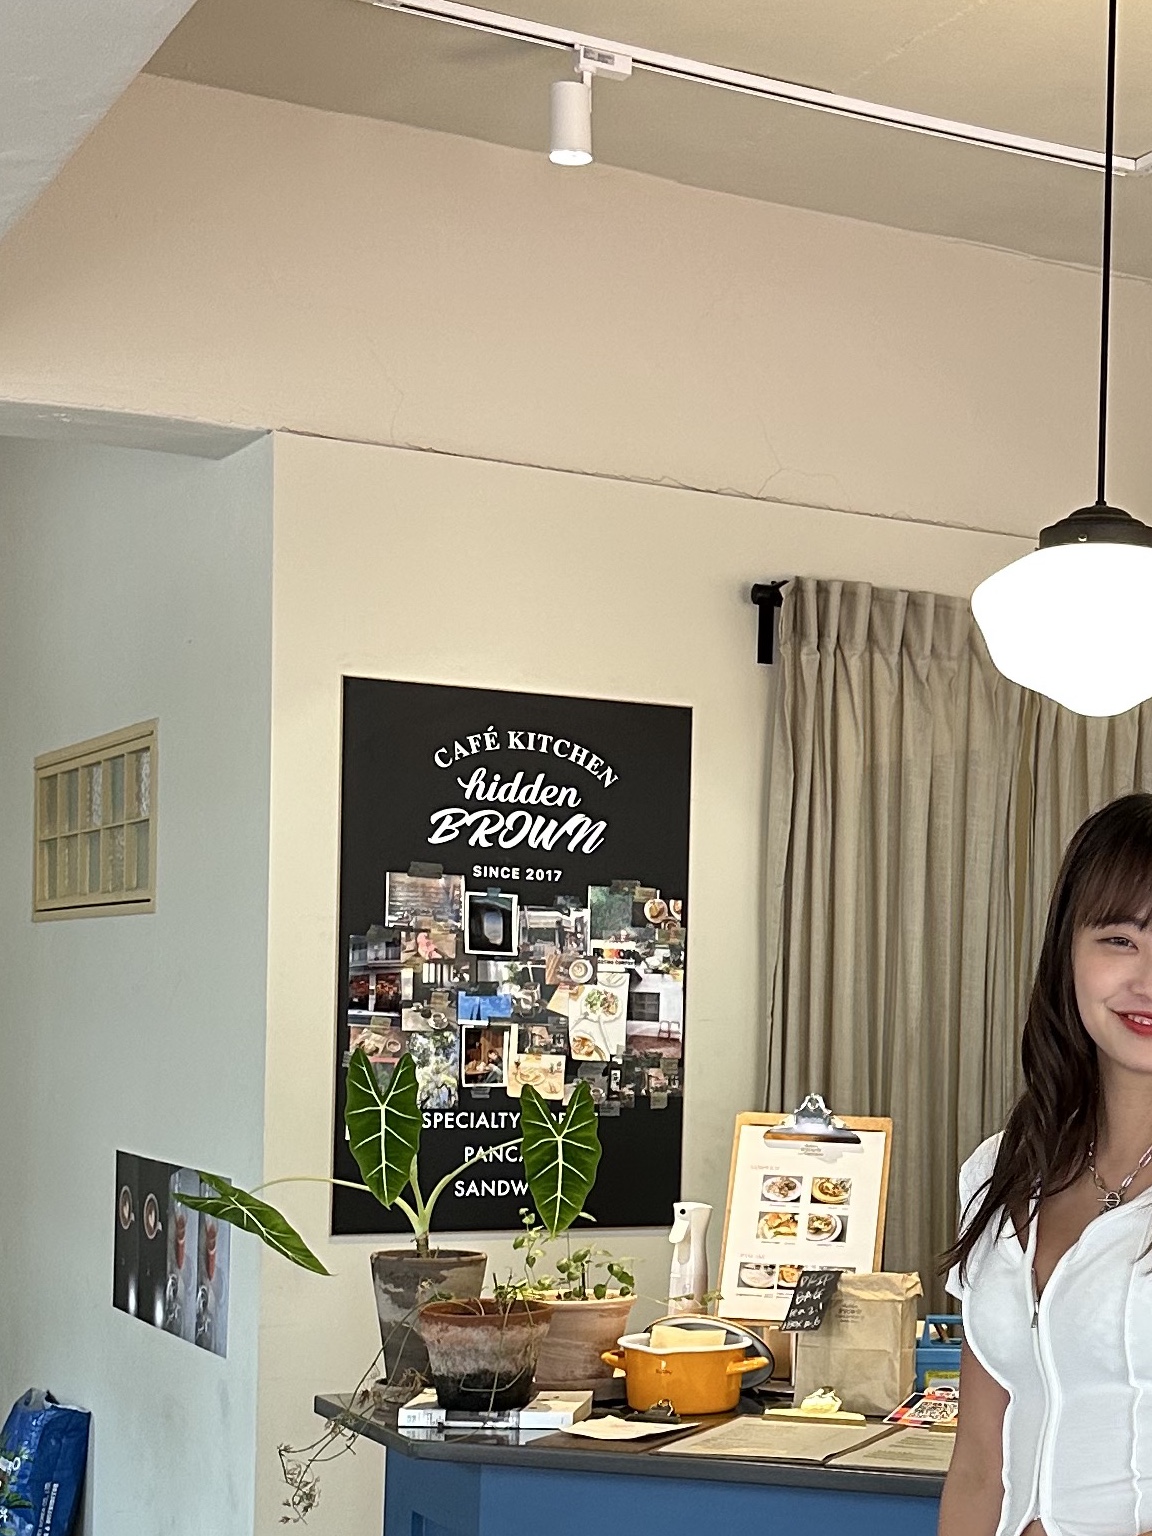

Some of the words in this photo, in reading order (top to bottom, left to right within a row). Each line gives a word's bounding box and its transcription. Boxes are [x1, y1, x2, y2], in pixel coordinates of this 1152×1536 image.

[434, 725, 500, 768] CAFÉ
[507, 730, 619, 789] KITCHEN
[457, 767, 582, 808] hidden
[427, 807, 608, 854] BROWN
[472, 865, 520, 880] SINCE
[525, 868, 563, 882] 2017
[422, 1111, 521, 1129] SPECIALTY
